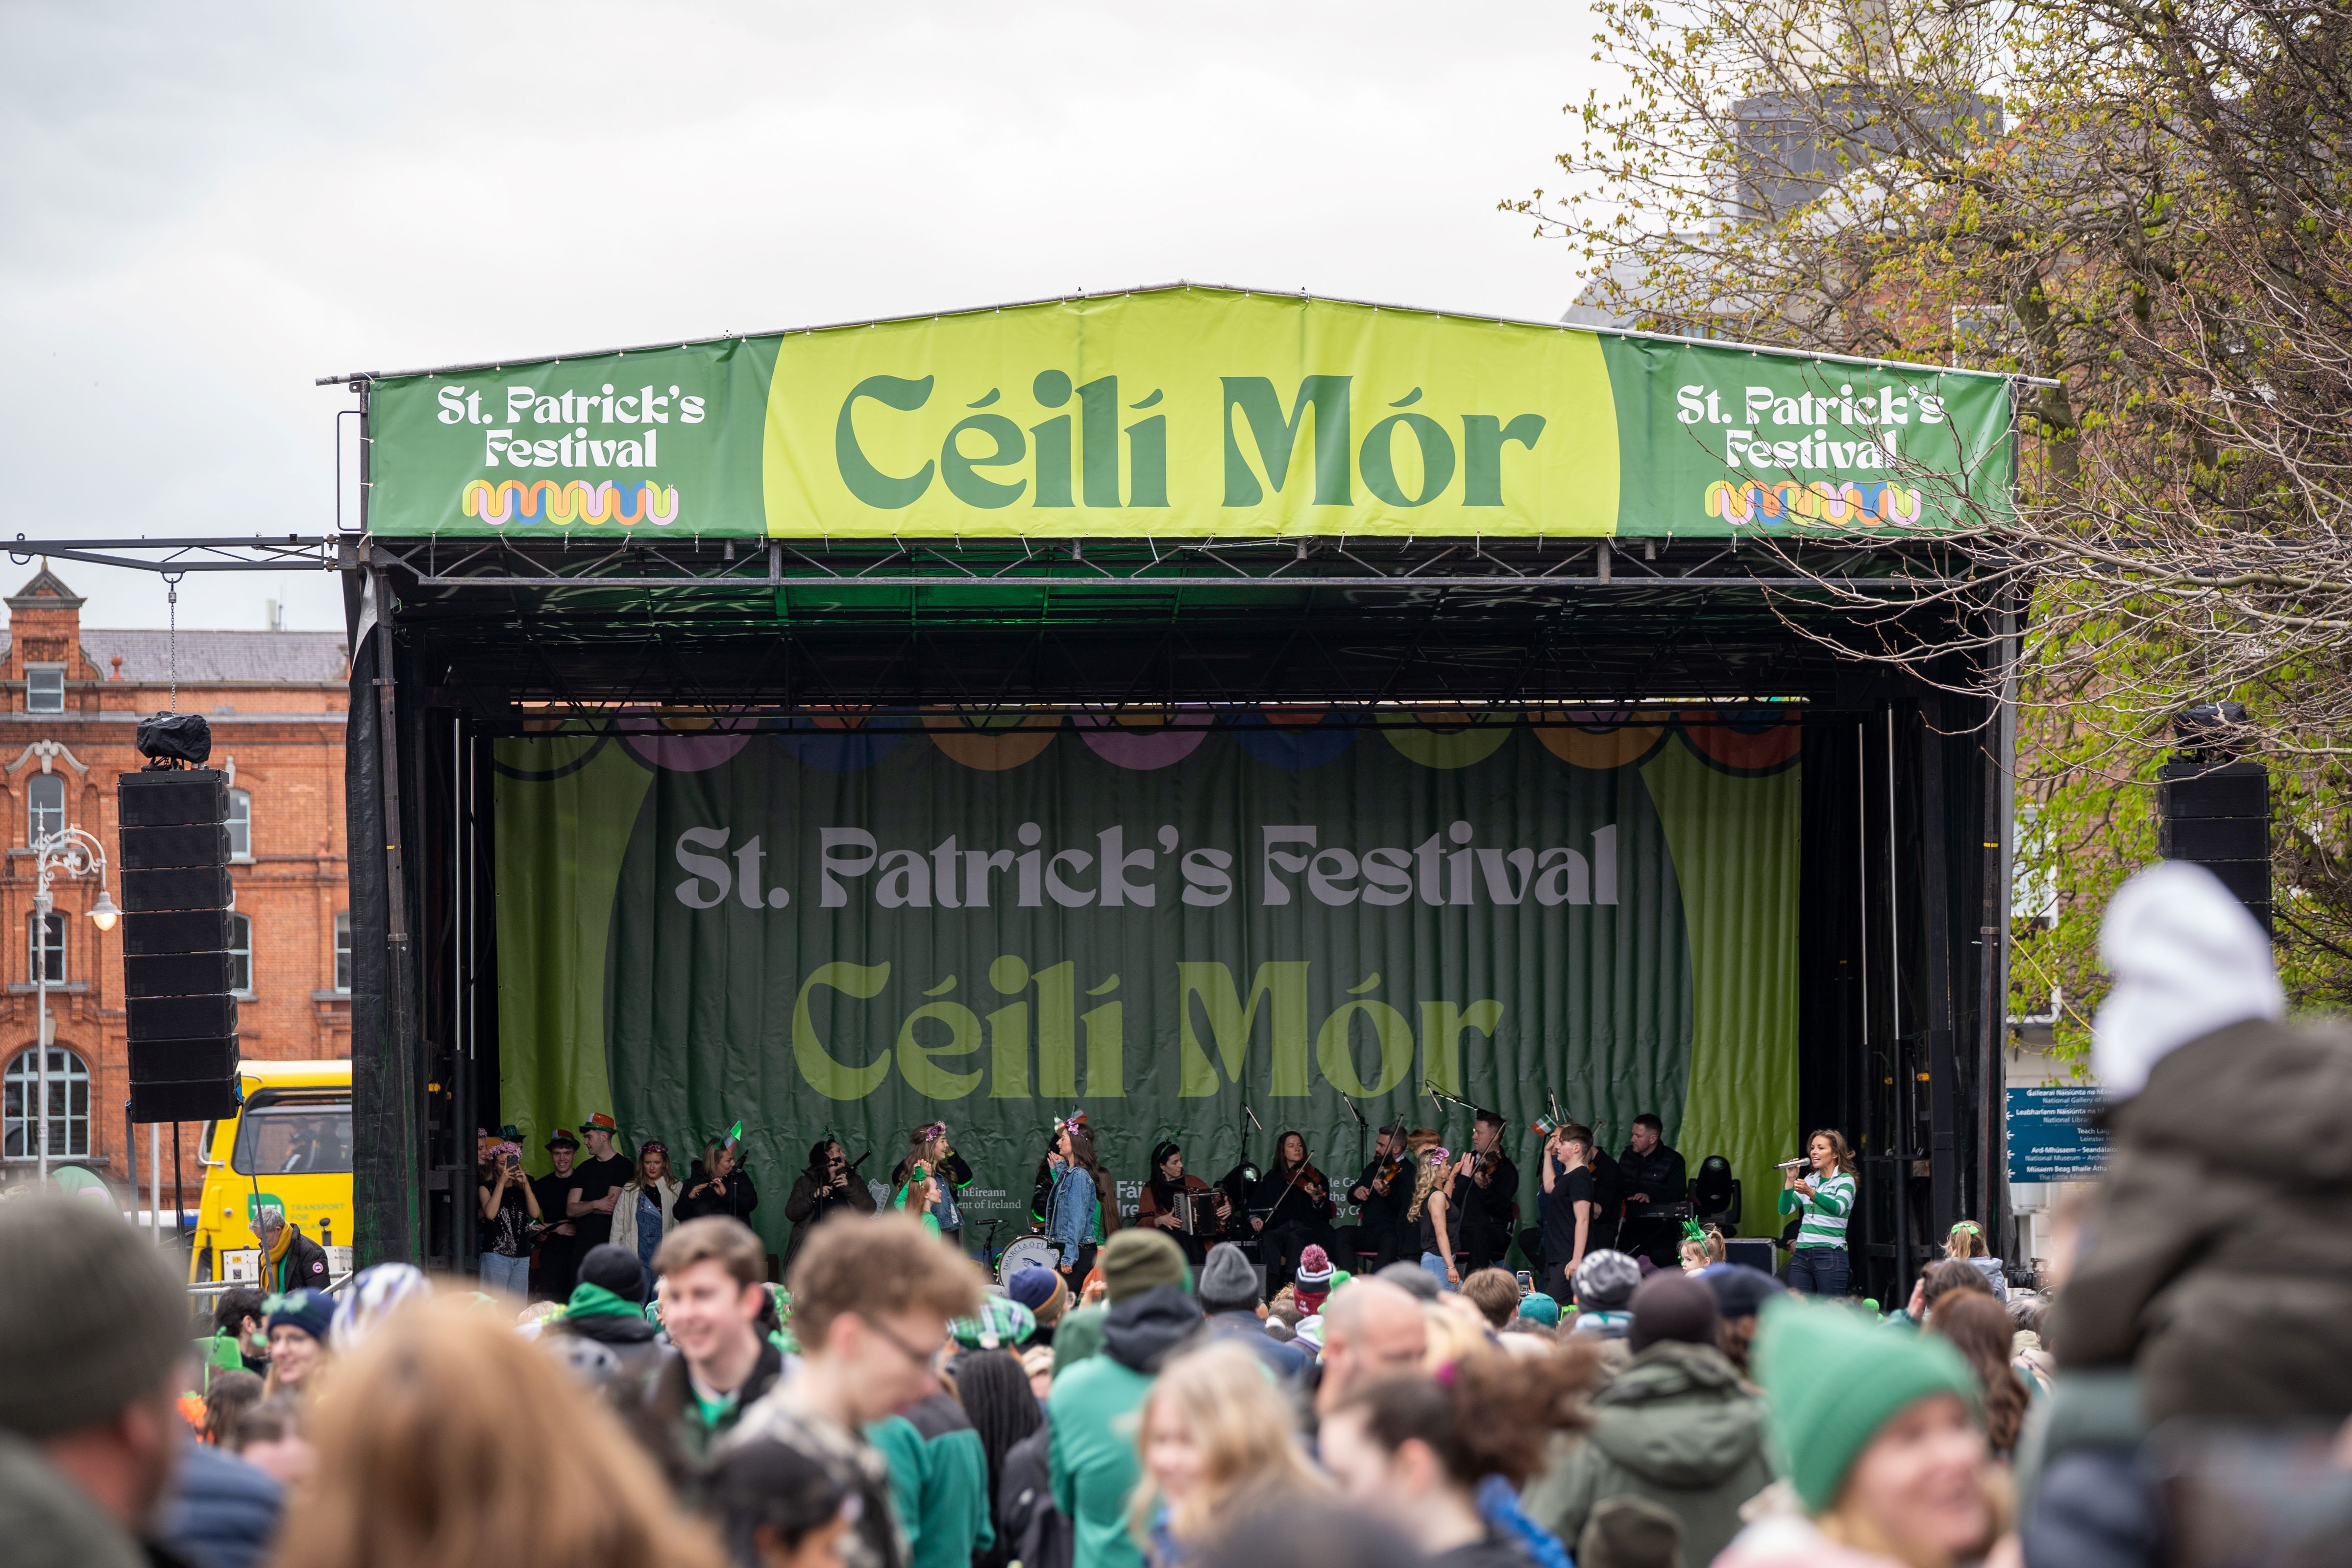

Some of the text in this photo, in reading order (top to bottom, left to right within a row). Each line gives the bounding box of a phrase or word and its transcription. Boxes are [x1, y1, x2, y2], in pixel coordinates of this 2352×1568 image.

[437, 383, 705, 424] St. Patrick’s
[1677, 384, 1946, 425] St. Patrick’s
[485, 427, 657, 468] Festival
[836, 368, 1545, 510] Céilí Mór
[1726, 429, 1897, 469] Festival
[674, 819, 1618, 909] St. Patrick’s Festival
[792, 954, 1505, 1101] Céilí Mór
[2054, 1165, 2071, 1174] Beag
[962, 1186, 1006, 1197] hÉireann
[974, 1200, 986, 1209] of
[987, 1200, 1021, 1208] Ireland
